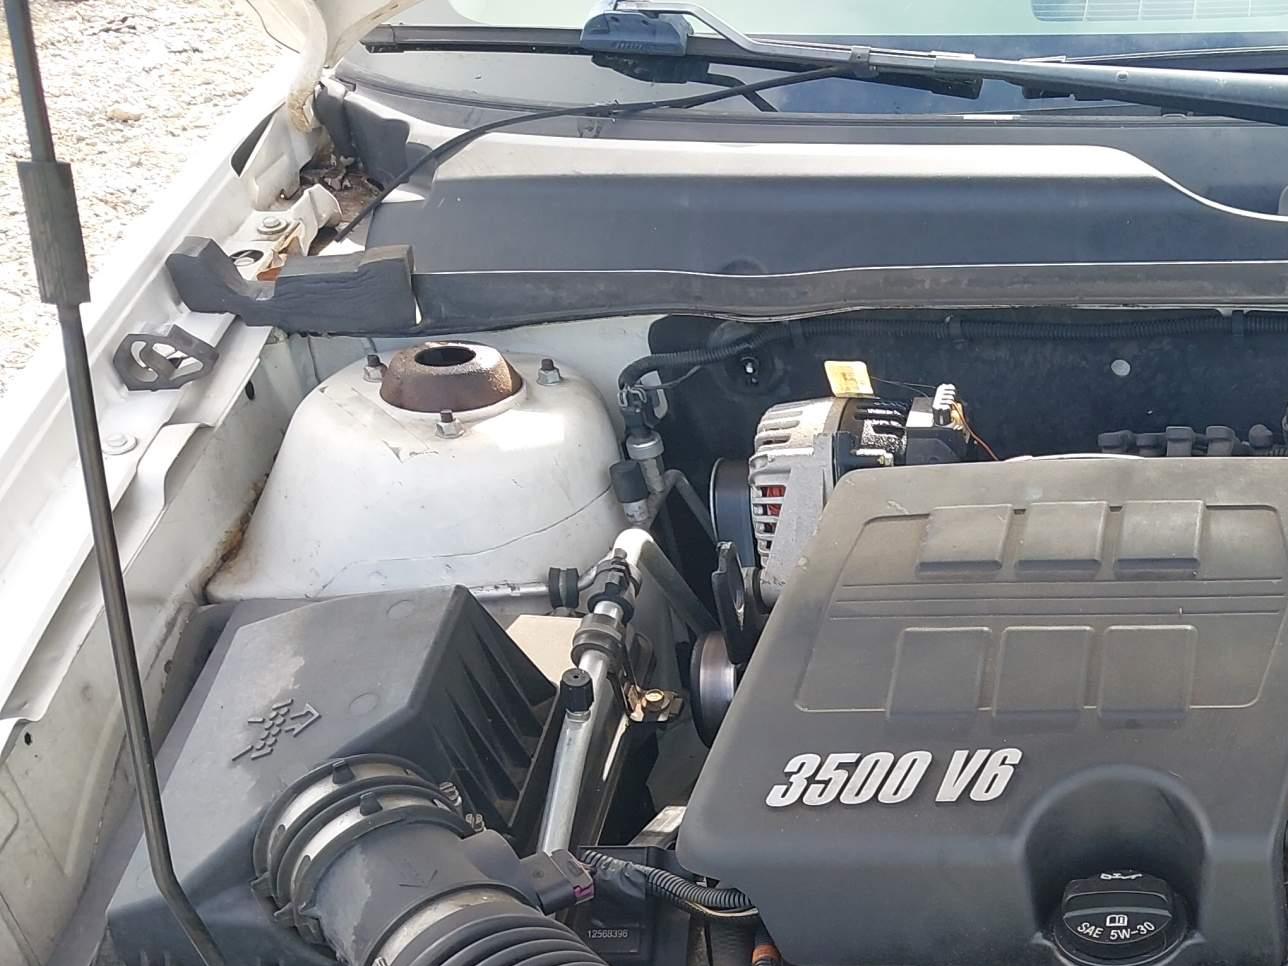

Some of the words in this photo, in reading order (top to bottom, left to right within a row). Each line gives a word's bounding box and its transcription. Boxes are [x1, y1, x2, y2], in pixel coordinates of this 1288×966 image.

[765, 750, 933, 807] 3500
[935, 747, 1023, 803] V6
[1077, 922, 1104, 938] SAE
[1110, 921, 1155, 940] 5W-30
